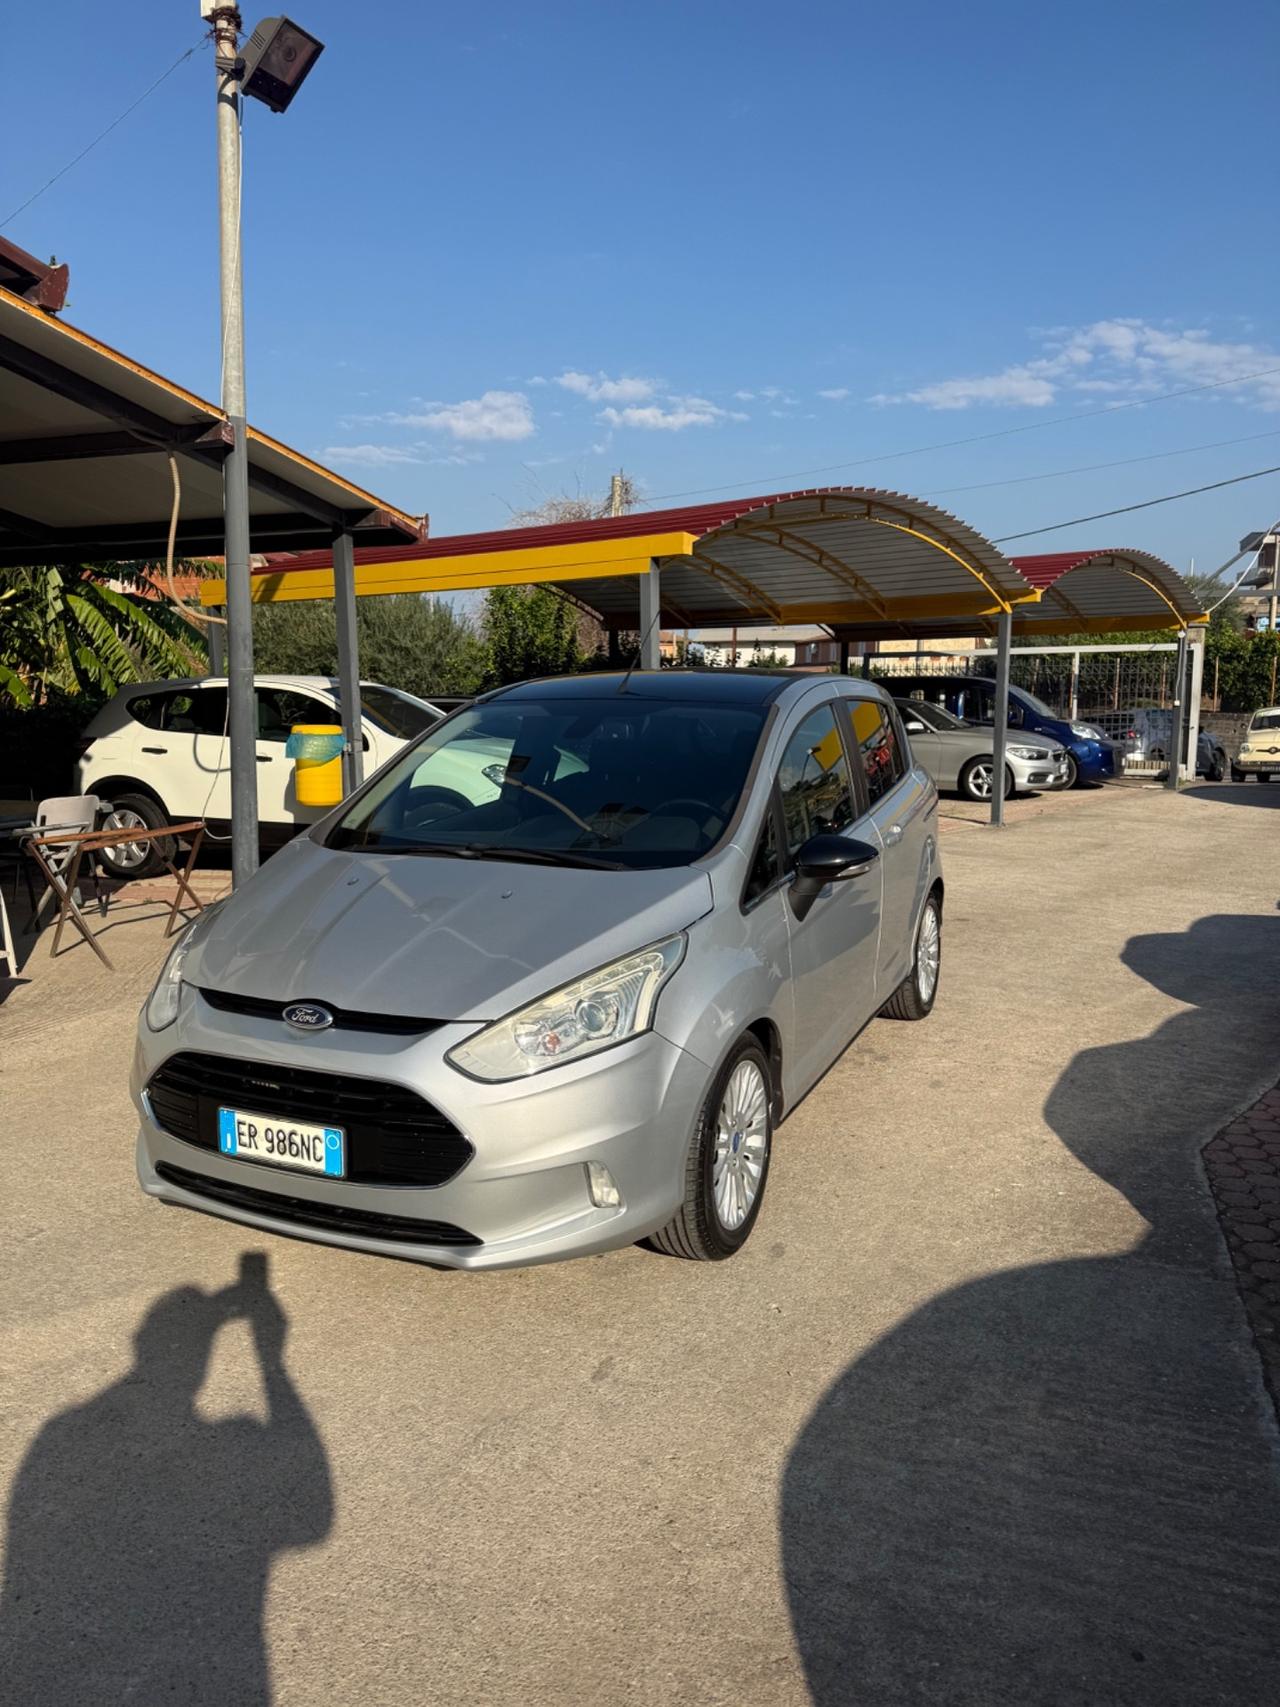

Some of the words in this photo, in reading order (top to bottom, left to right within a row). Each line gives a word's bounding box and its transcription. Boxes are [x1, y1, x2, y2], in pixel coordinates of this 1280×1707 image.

[291, 1007, 320, 1024] Ford
[237, 1120, 259, 1150] ER
[264, 1127, 324, 1162] 986NC
